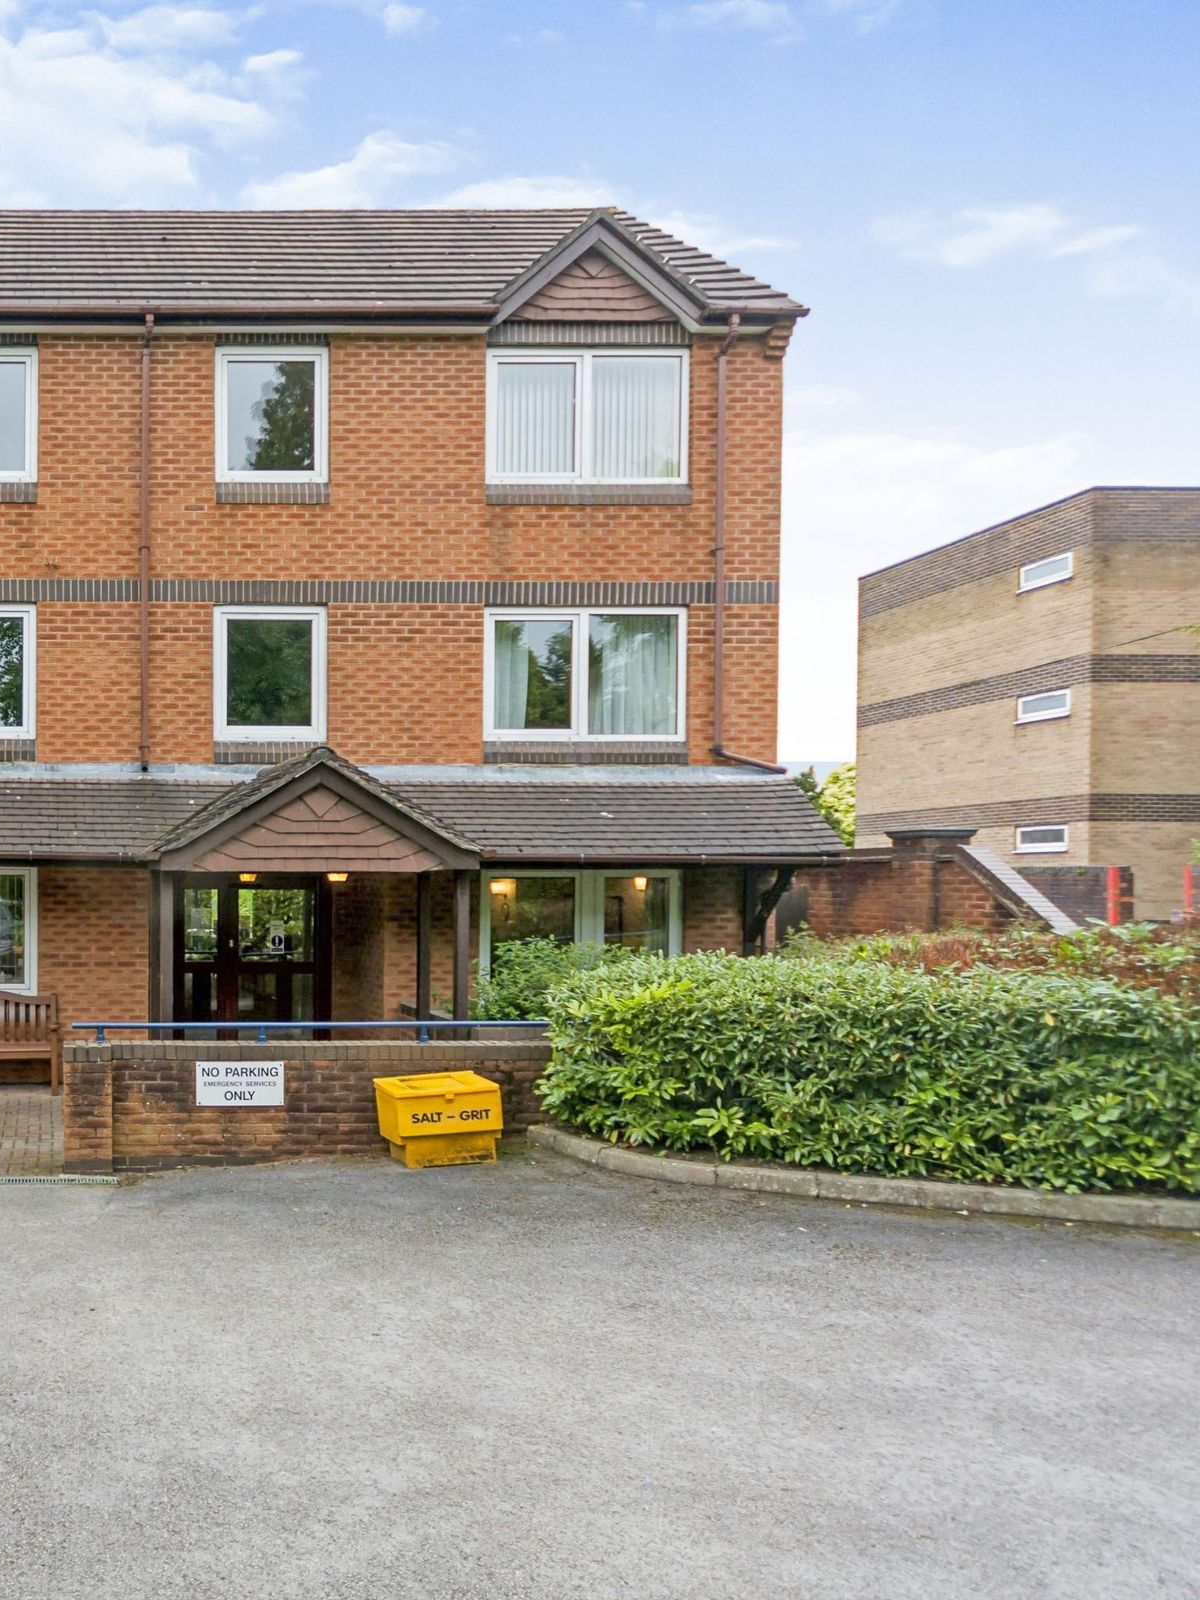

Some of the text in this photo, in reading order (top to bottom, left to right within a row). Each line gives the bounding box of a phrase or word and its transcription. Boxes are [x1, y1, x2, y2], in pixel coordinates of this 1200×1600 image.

[201, 1067, 279, 1077] NO PARKING
[224, 1090, 256, 1101] ONLY
[411, 1111, 443, 1124] SALT
[459, 1108, 491, 1121] GRIT
